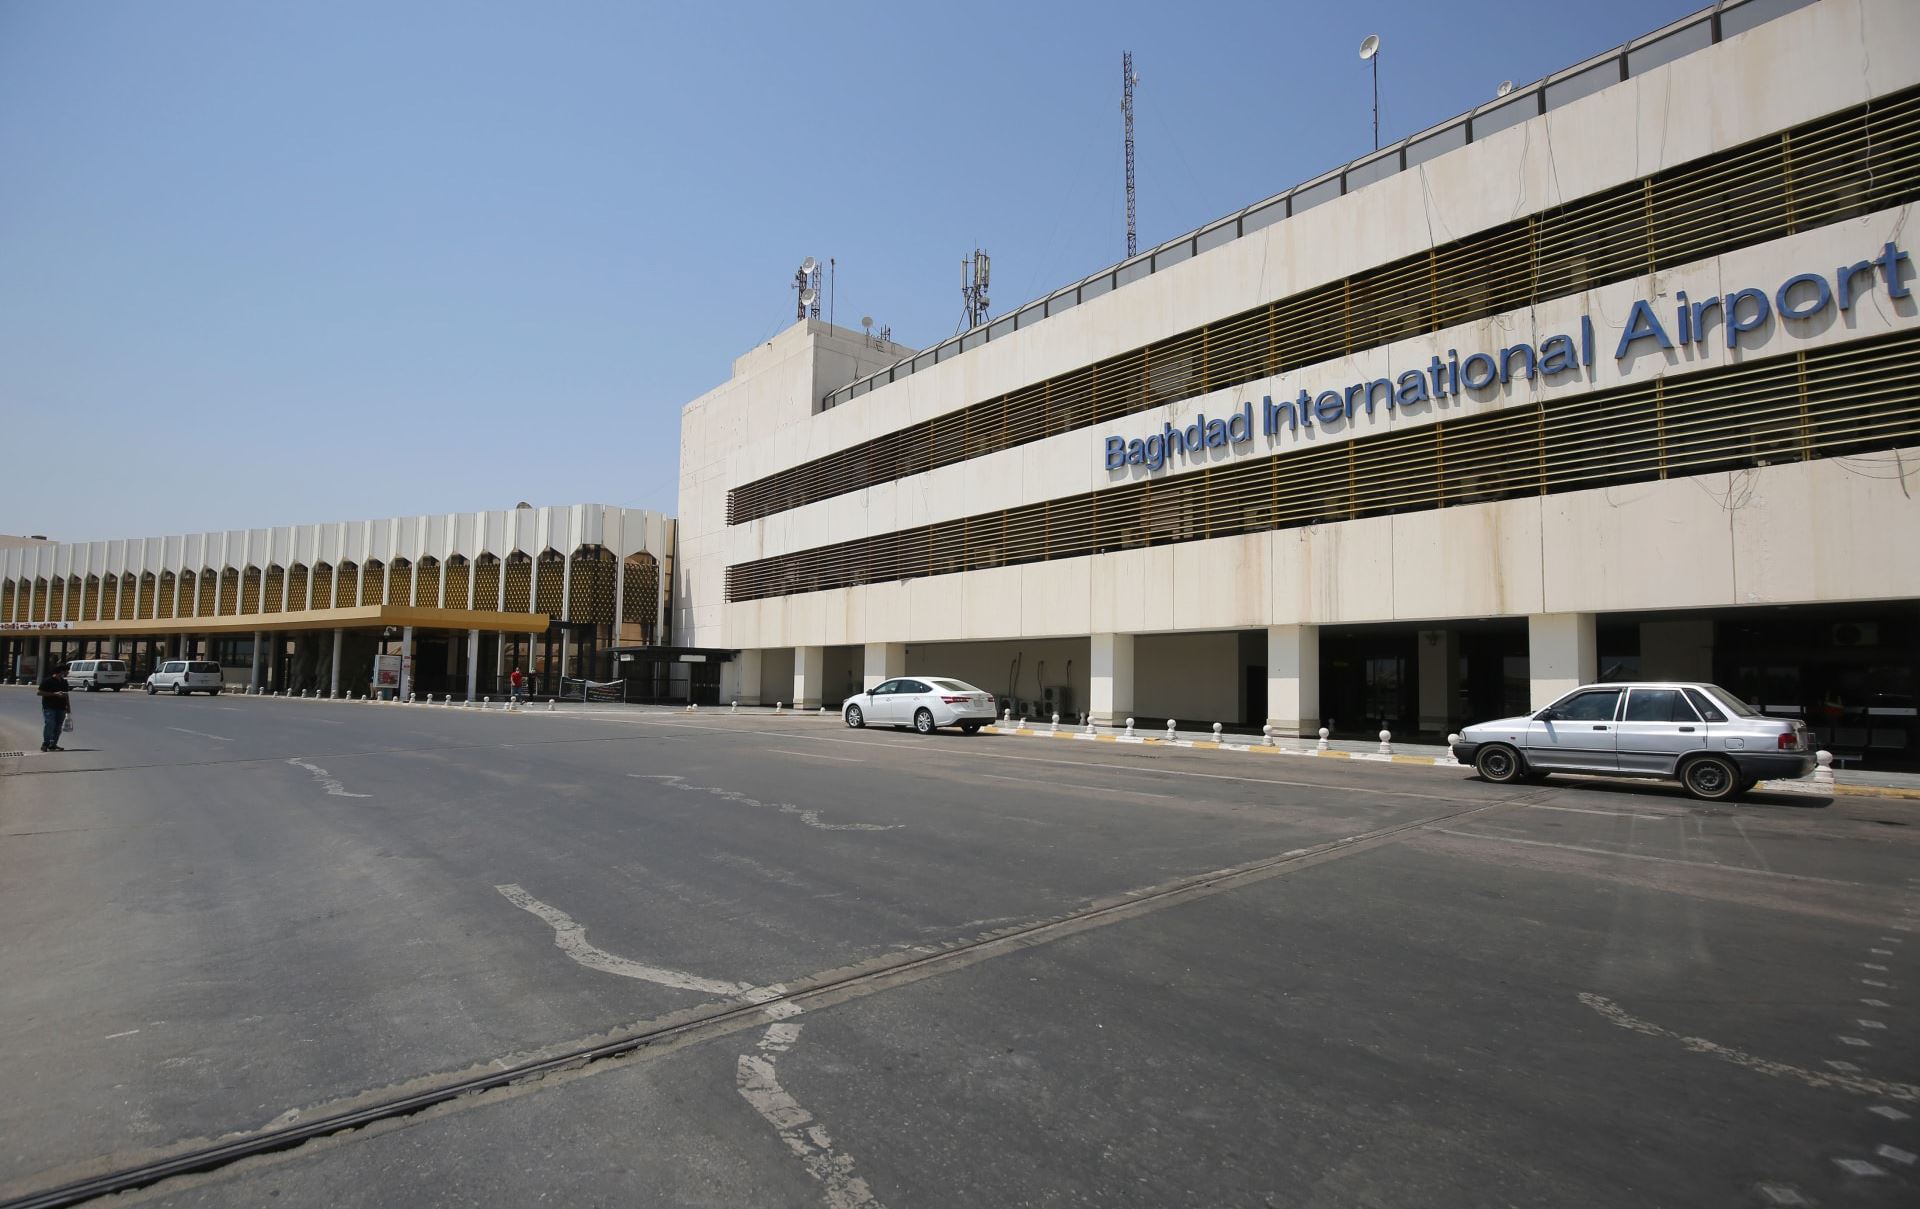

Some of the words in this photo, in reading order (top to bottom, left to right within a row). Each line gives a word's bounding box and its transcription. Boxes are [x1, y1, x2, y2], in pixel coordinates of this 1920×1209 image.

[1104, 401, 1251, 473] Baghdad
[1263, 316, 1591, 436] International
[1615, 242, 1911, 361] Airport
